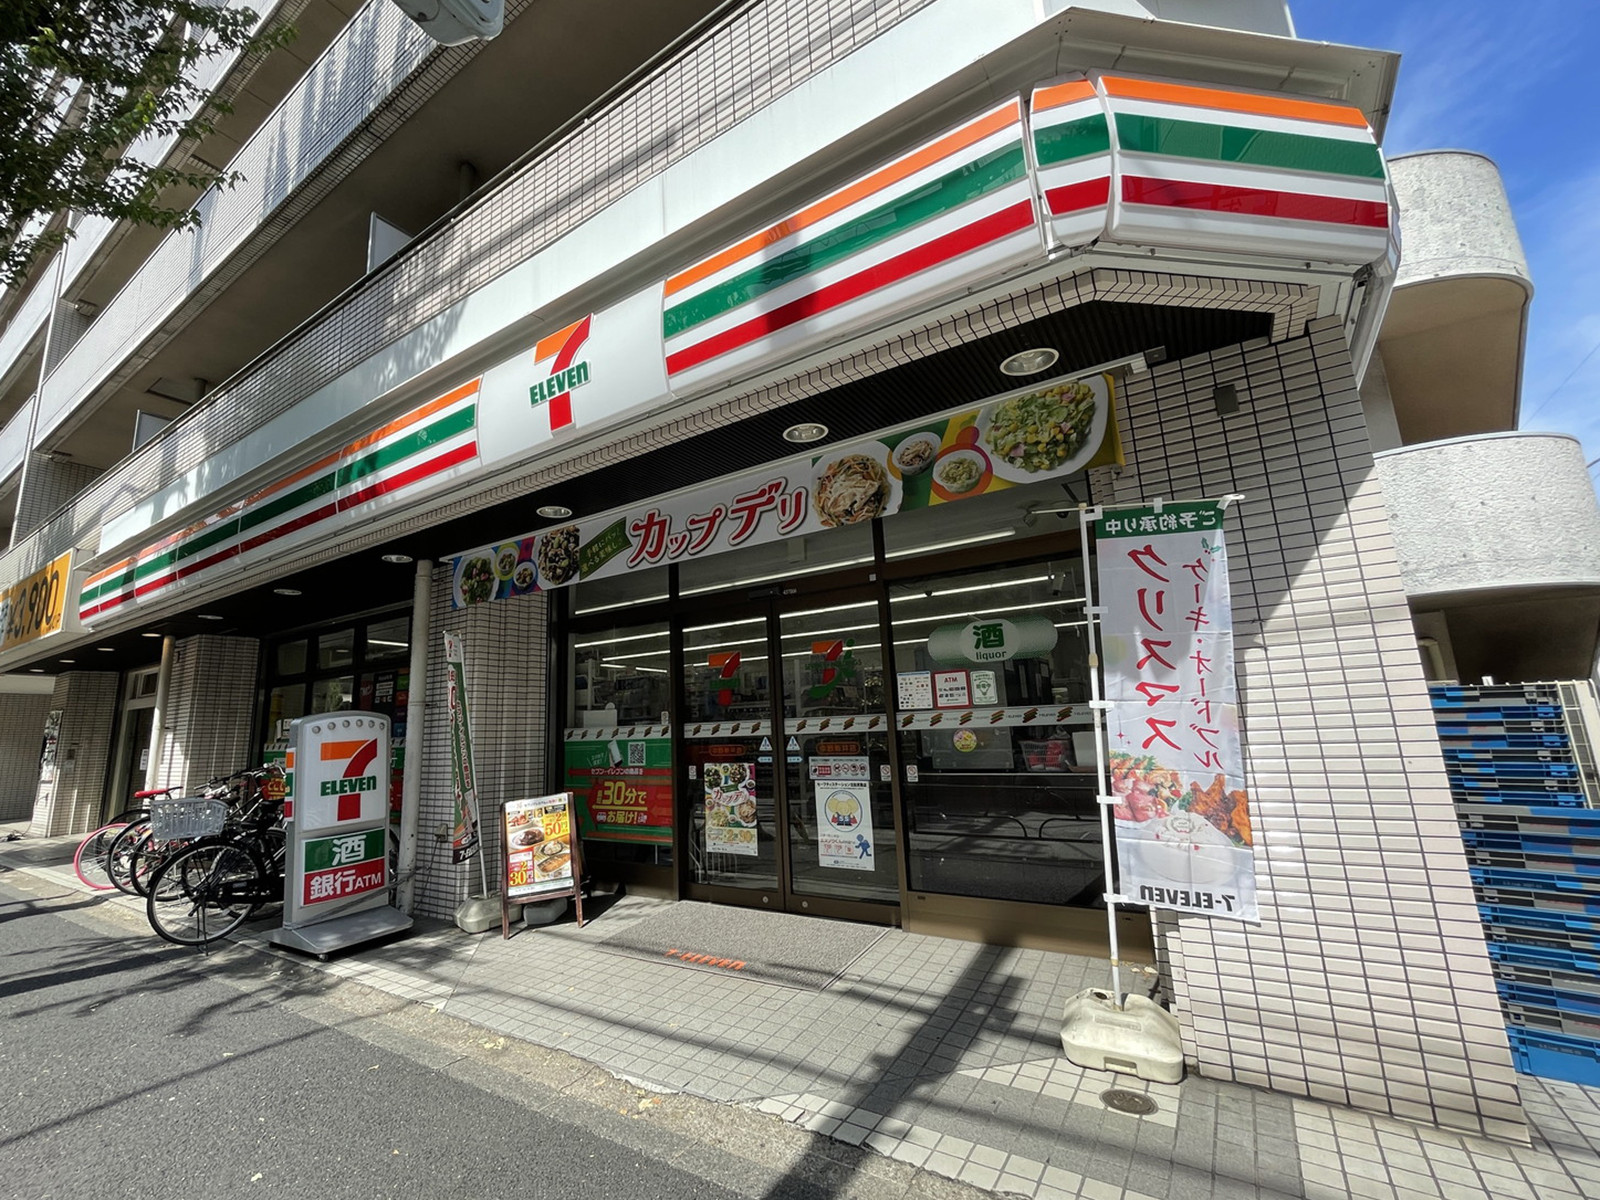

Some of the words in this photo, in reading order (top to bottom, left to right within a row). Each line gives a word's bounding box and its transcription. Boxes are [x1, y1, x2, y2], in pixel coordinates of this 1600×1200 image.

[628, 479, 806, 566] カップデリ
[972, 622, 1005, 650] 酒
[975, 650, 1007, 661] liquor
[331, 834, 367, 866] 酒
